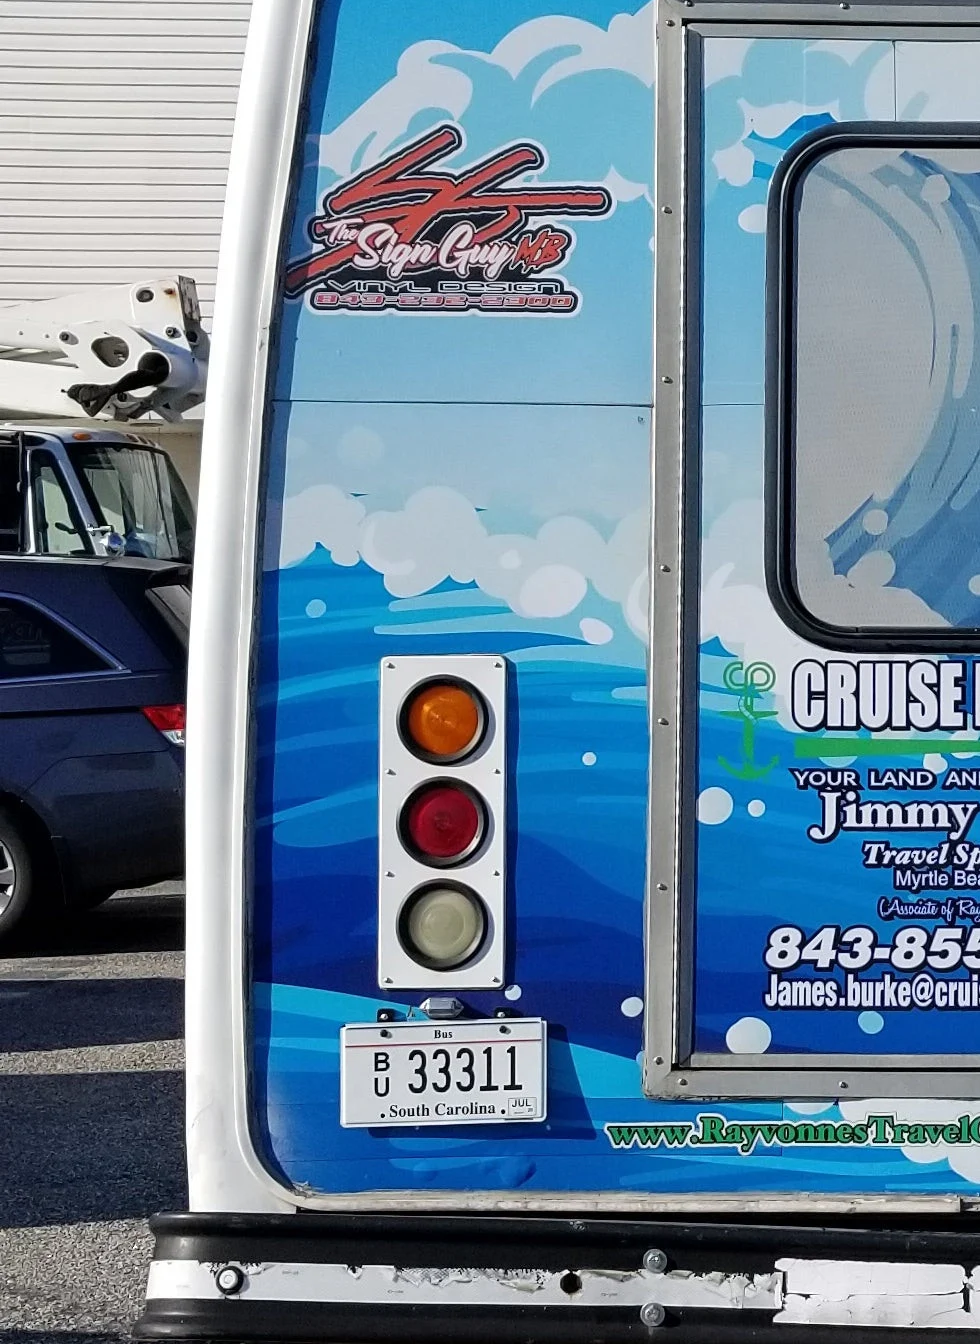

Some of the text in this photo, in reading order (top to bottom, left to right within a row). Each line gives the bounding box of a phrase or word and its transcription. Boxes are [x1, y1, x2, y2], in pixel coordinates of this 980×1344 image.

[323, 217, 363, 244] The
[353, 222, 438, 277] Sign
[440, 221, 515, 278] Guy
[792, 659, 968, 732] CRUISE
[795, 770, 857, 787] YOUR
[870, 771, 934, 787] LAND
[810, 790, 978, 840] Jimmy
[863, 842, 948, 865] Travel
[895, 869, 949, 890] Myrtle
[879, 898, 938, 918] (Associate
[940, 899, 954, 922] of
[434, 1029, 453, 1039] Bus
[407, 1045, 523, 1094] 33311
[389, 1101, 496, 1118] South Carolina
[511, 1098, 532, 1108] JUL
